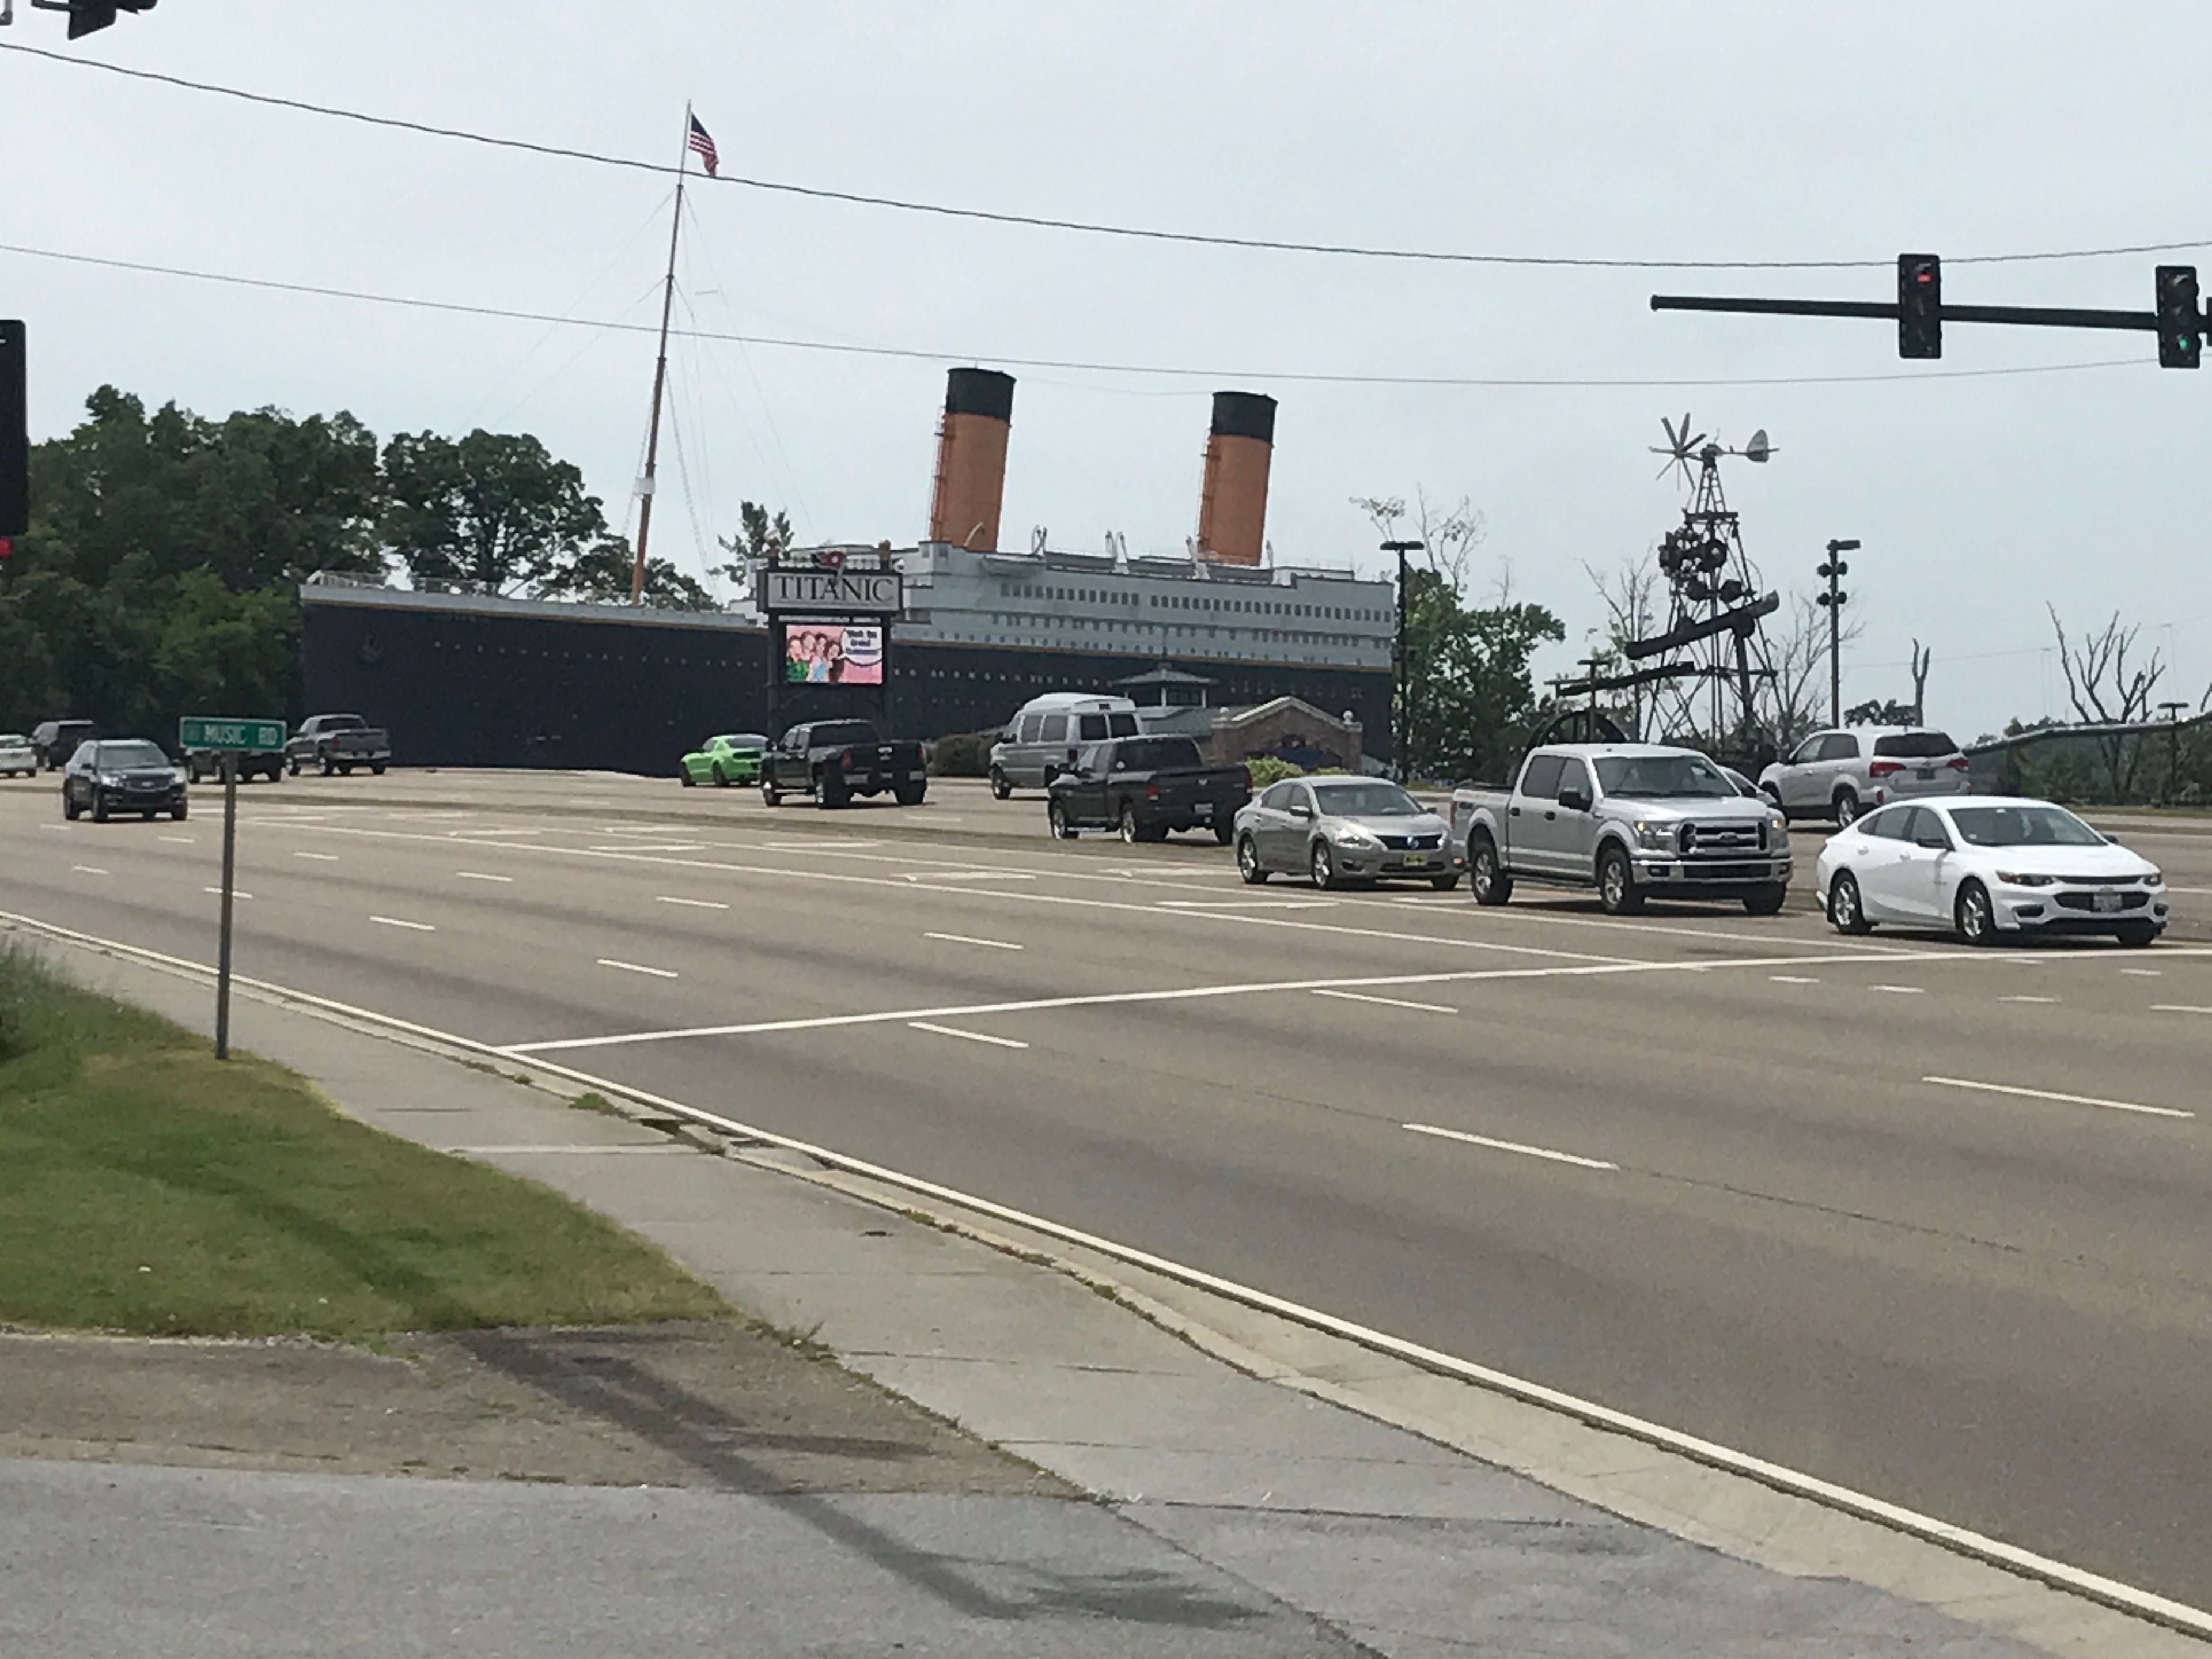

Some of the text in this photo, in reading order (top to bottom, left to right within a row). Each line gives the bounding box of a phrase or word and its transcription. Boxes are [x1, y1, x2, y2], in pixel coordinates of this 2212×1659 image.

[775, 576, 893, 601] TITANIC
[204, 724, 246, 744] MUSIC
[259, 726, 278, 745] RD
